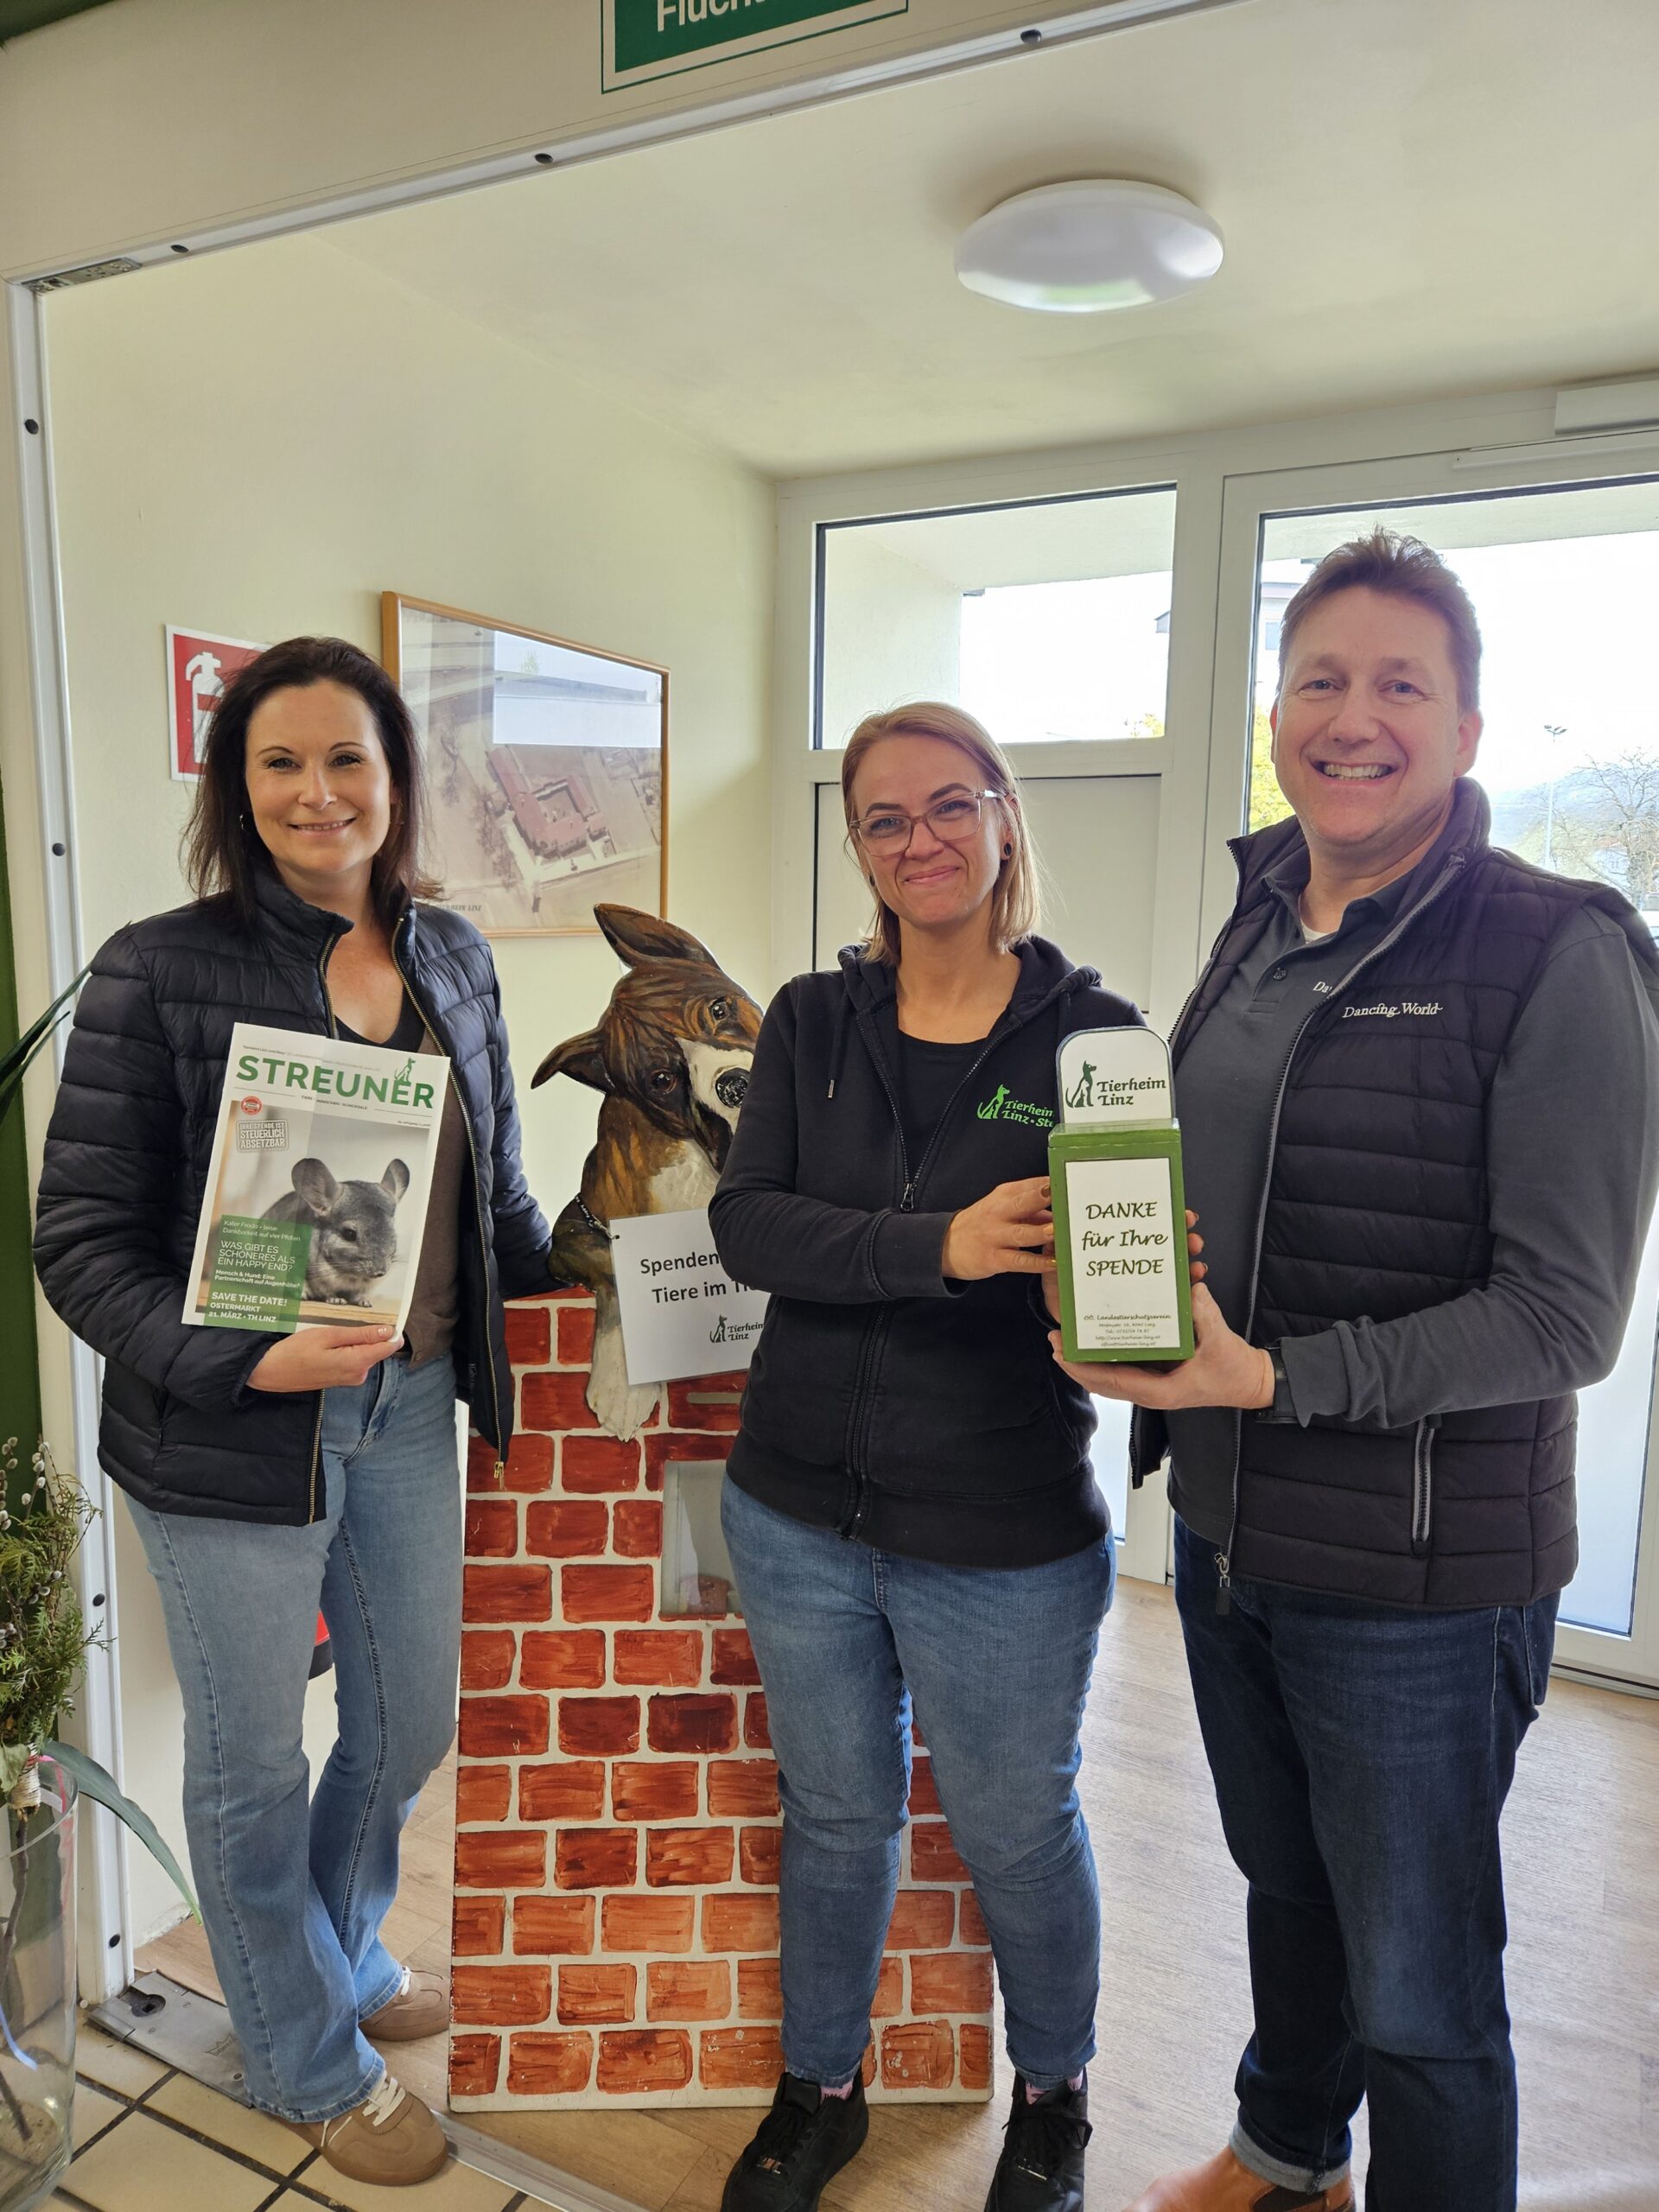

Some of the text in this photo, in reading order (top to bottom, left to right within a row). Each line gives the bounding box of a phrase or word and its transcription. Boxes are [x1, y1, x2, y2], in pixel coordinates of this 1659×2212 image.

[658, 0, 766, 32] Fluc
[1342, 1002, 1443, 1018] Dancing World
[236, 1055, 435, 1109] STREUNER
[1096, 1077, 1166, 1092] Tierheim
[1097, 1094, 1134, 1106] Linz
[1001, 1110, 1028, 1124] Linz
[240, 1128, 284, 1139] STEUERLICH
[241, 1138, 285, 1148] ABSETZBAR
[1085, 1201, 1158, 1219] DANKE
[222, 1227, 258, 1236] Dankbarkeit
[1082, 1229, 1168, 1250] für Ihre
[220, 1240, 279, 1254] WAS GIBT ES
[218, 1256, 293, 1272] EIN HAPPY END?
[277, 1255, 296, 1264] ALS
[640, 1252, 721, 1276] Spenden
[1086, 1258, 1164, 1276] SPENDE
[214, 1274, 253, 1284] Partnerschaft
[211, 1292, 288, 1306] SAVE THE DATE!
[652, 1287, 698, 1304] Tiere
[704, 1281, 726, 1297] im
[210, 1301, 261, 1313] OSTERMARKT
[220, 1311, 242, 1319] MÄRZ
[728, 1332, 749, 1341] Linz
